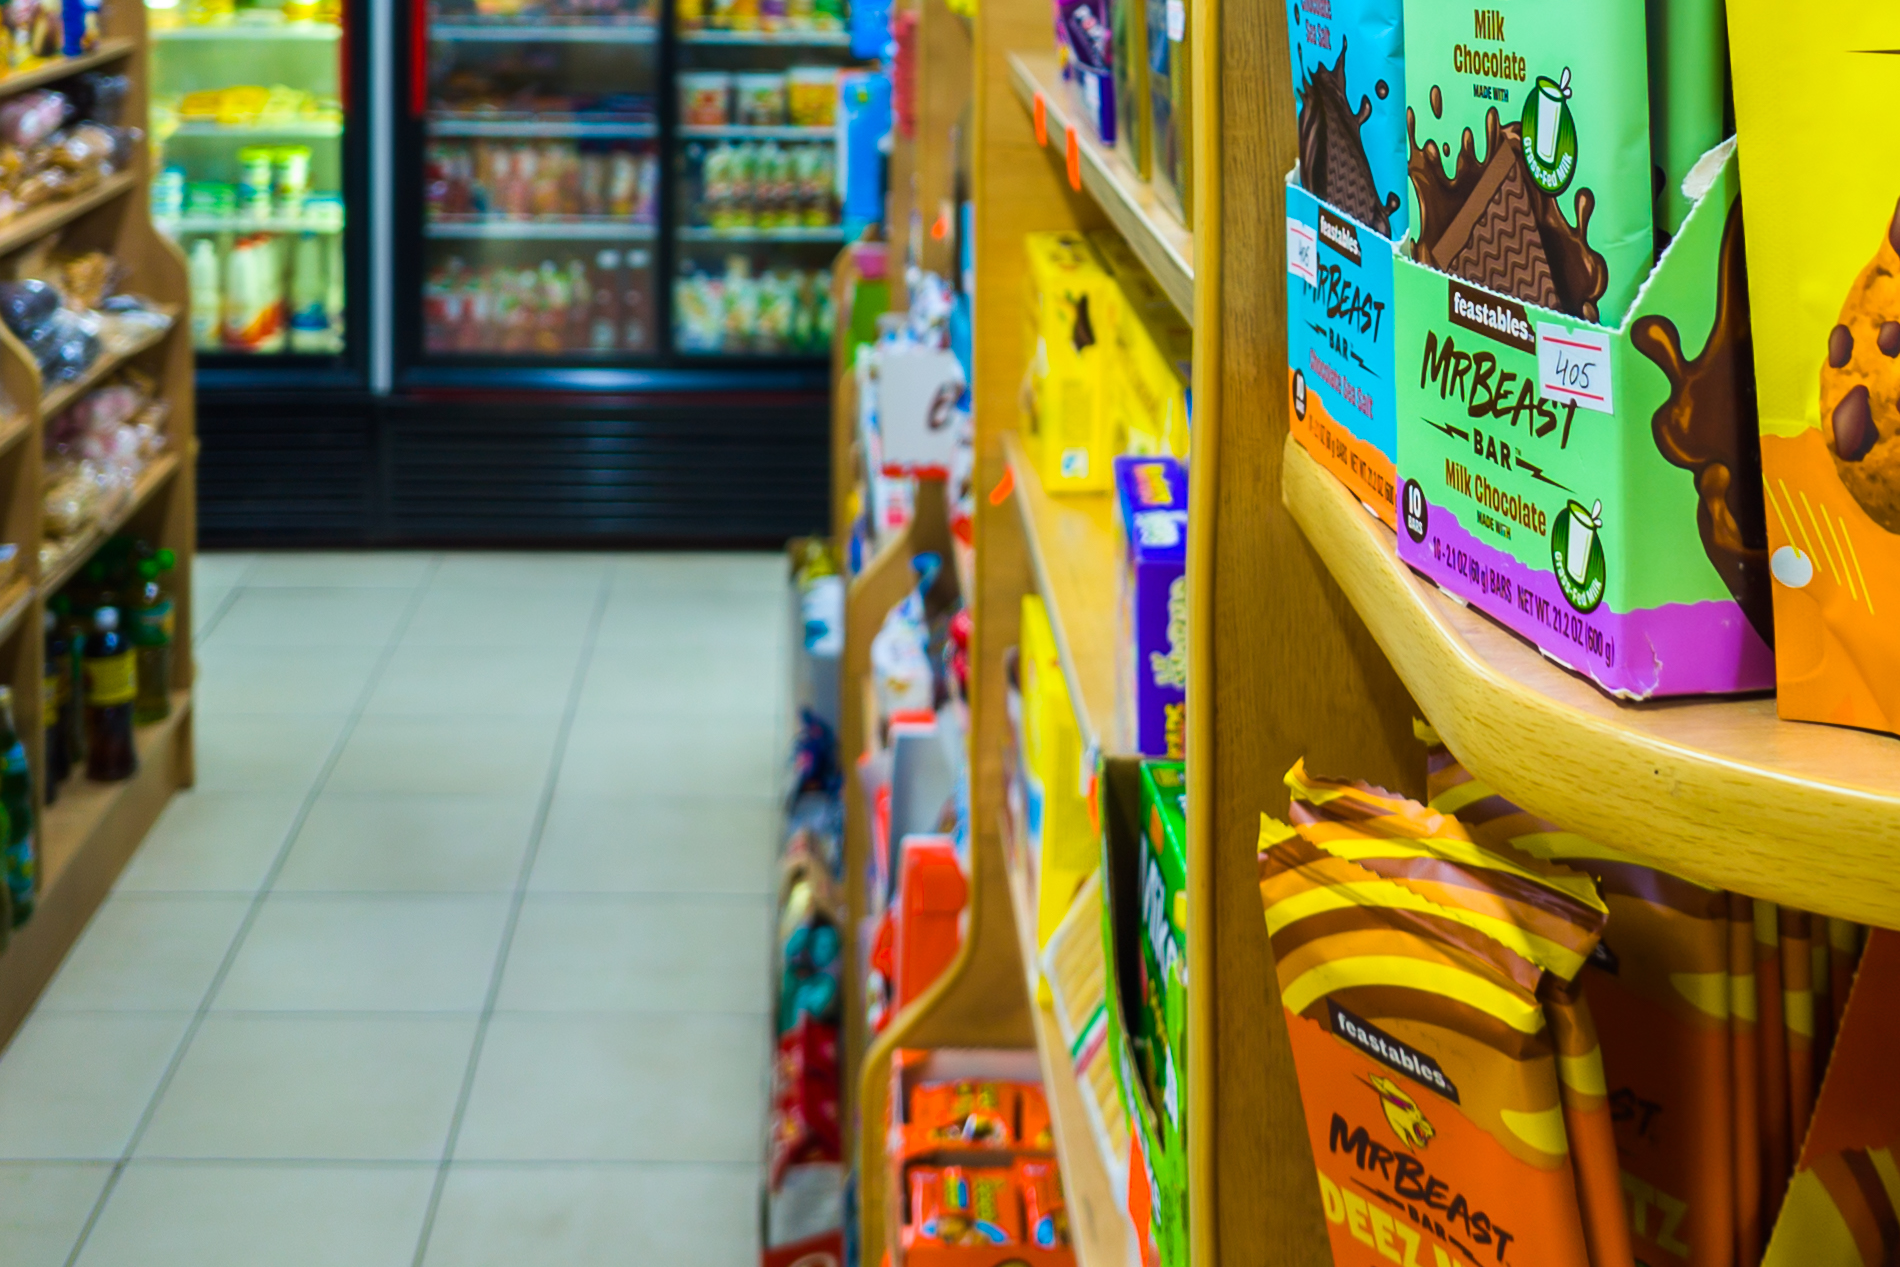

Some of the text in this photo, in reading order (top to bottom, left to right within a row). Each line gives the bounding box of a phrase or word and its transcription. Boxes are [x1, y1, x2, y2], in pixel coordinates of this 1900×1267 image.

[1473, 9, 1505, 42] Milk
[1453, 43, 1527, 83] Chocolate
[1473, 83, 1509, 103] MADE WITH
[1320, 214, 1359, 255] feastables
[1453, 291, 1529, 342] feastables
[1329, 327, 1349, 362] BAR
[1555, 349, 1598, 390] 405
[1473, 427, 1513, 472] BAR
[1408, 484, 1422, 519] 10
[1444, 457, 1473, 499] Milk
[1474, 473, 1547, 537] Chocolate
[1407, 514, 1424, 536] BARS
[1477, 509, 1512, 541] MADE WITH
[1489, 568, 1512, 604] BARS
[1516, 583, 1534, 618] NET
[1571, 614, 1584, 647] OZ
[1584, 624, 1604, 659] (600
[1604, 635, 1615, 669] g)
[1337, 1010, 1448, 1091] feastables
[1407, 1203, 1447, 1242] BAR
